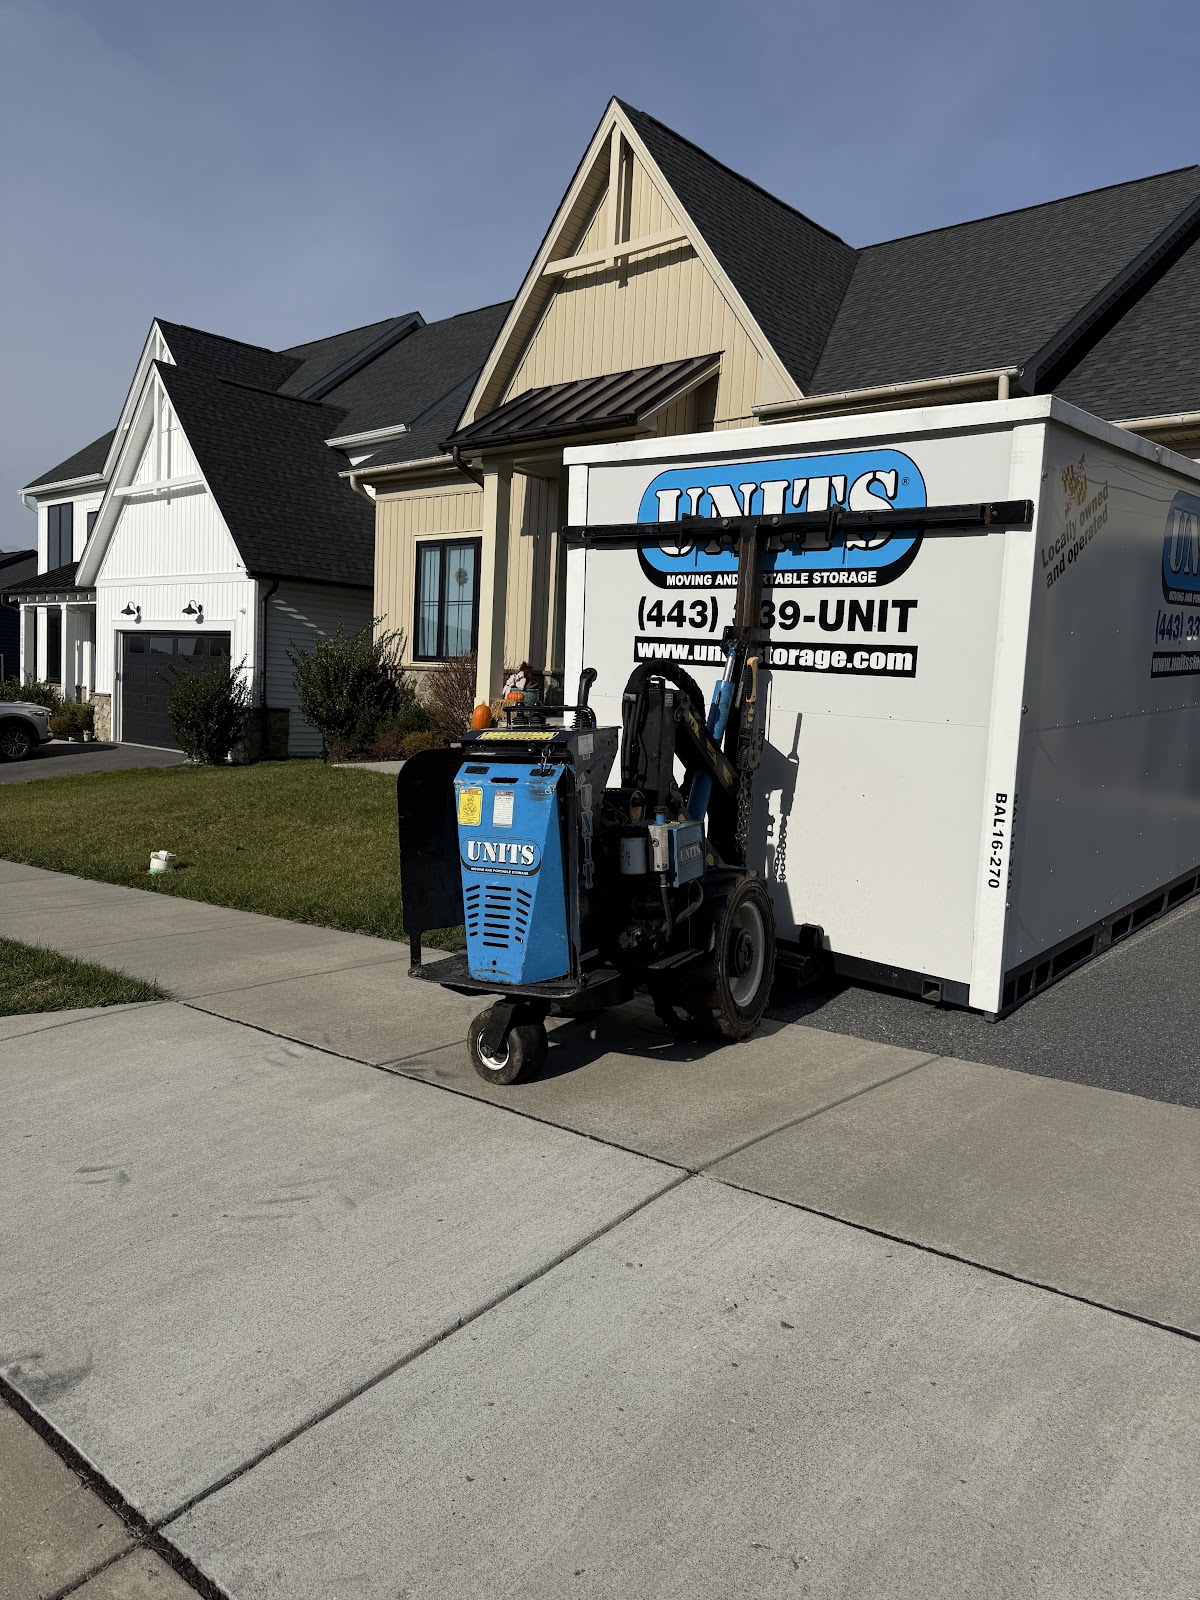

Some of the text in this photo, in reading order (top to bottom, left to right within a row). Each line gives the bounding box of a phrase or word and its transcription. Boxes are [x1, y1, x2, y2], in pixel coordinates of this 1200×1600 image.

[655, 469, 898, 557] UNITS
[1041, 480, 1108, 569] Locally owned
[1046, 503, 1108, 589] and operated
[666, 570, 877, 586] MOVING AND RTABLE STORAGE
[637, 596, 918, 632] (443) 39-UNIT
[1155, 610, 1184, 644] (443)
[467, 841, 534, 866] UNITS
[988, 792, 1008, 889] BAL16-270
